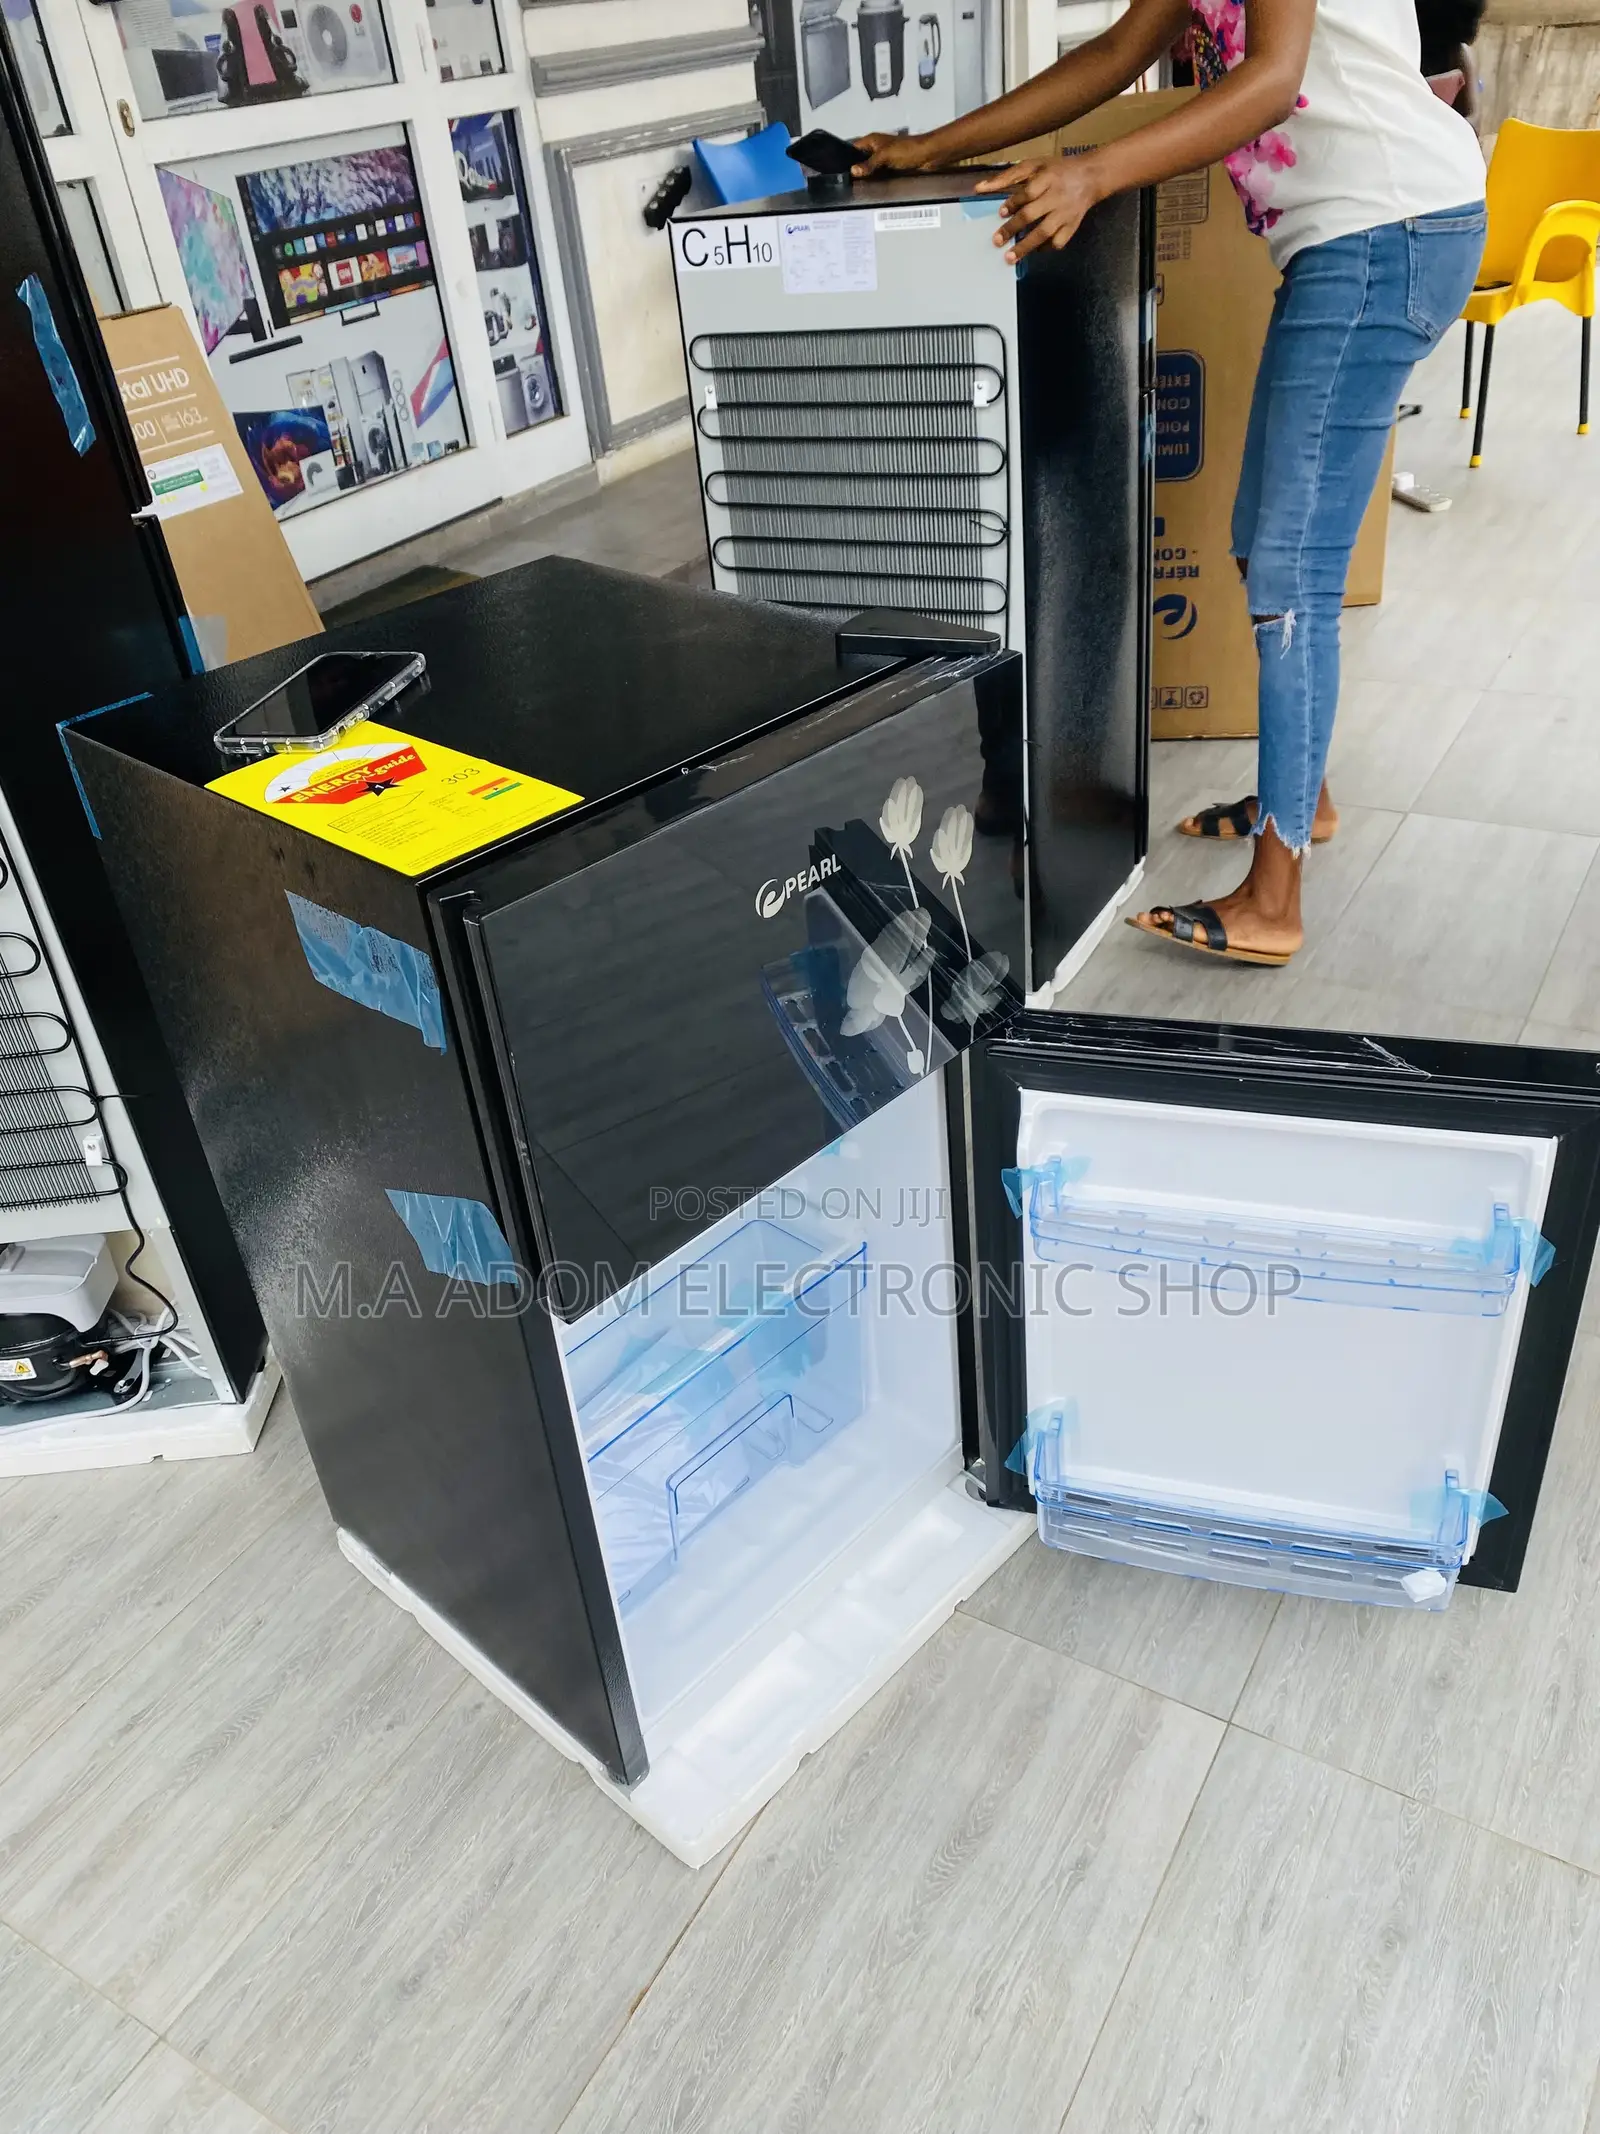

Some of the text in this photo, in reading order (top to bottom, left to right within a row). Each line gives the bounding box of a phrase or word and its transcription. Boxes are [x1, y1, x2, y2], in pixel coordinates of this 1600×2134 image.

[151, 367, 190, 392] UHD
[130, 420, 157, 442] 00
[290, 765, 373, 803] ENERGY
[373, 752, 416, 777] guide
[440, 767, 481, 786] 303
[785, 853, 842, 900] PEARL
